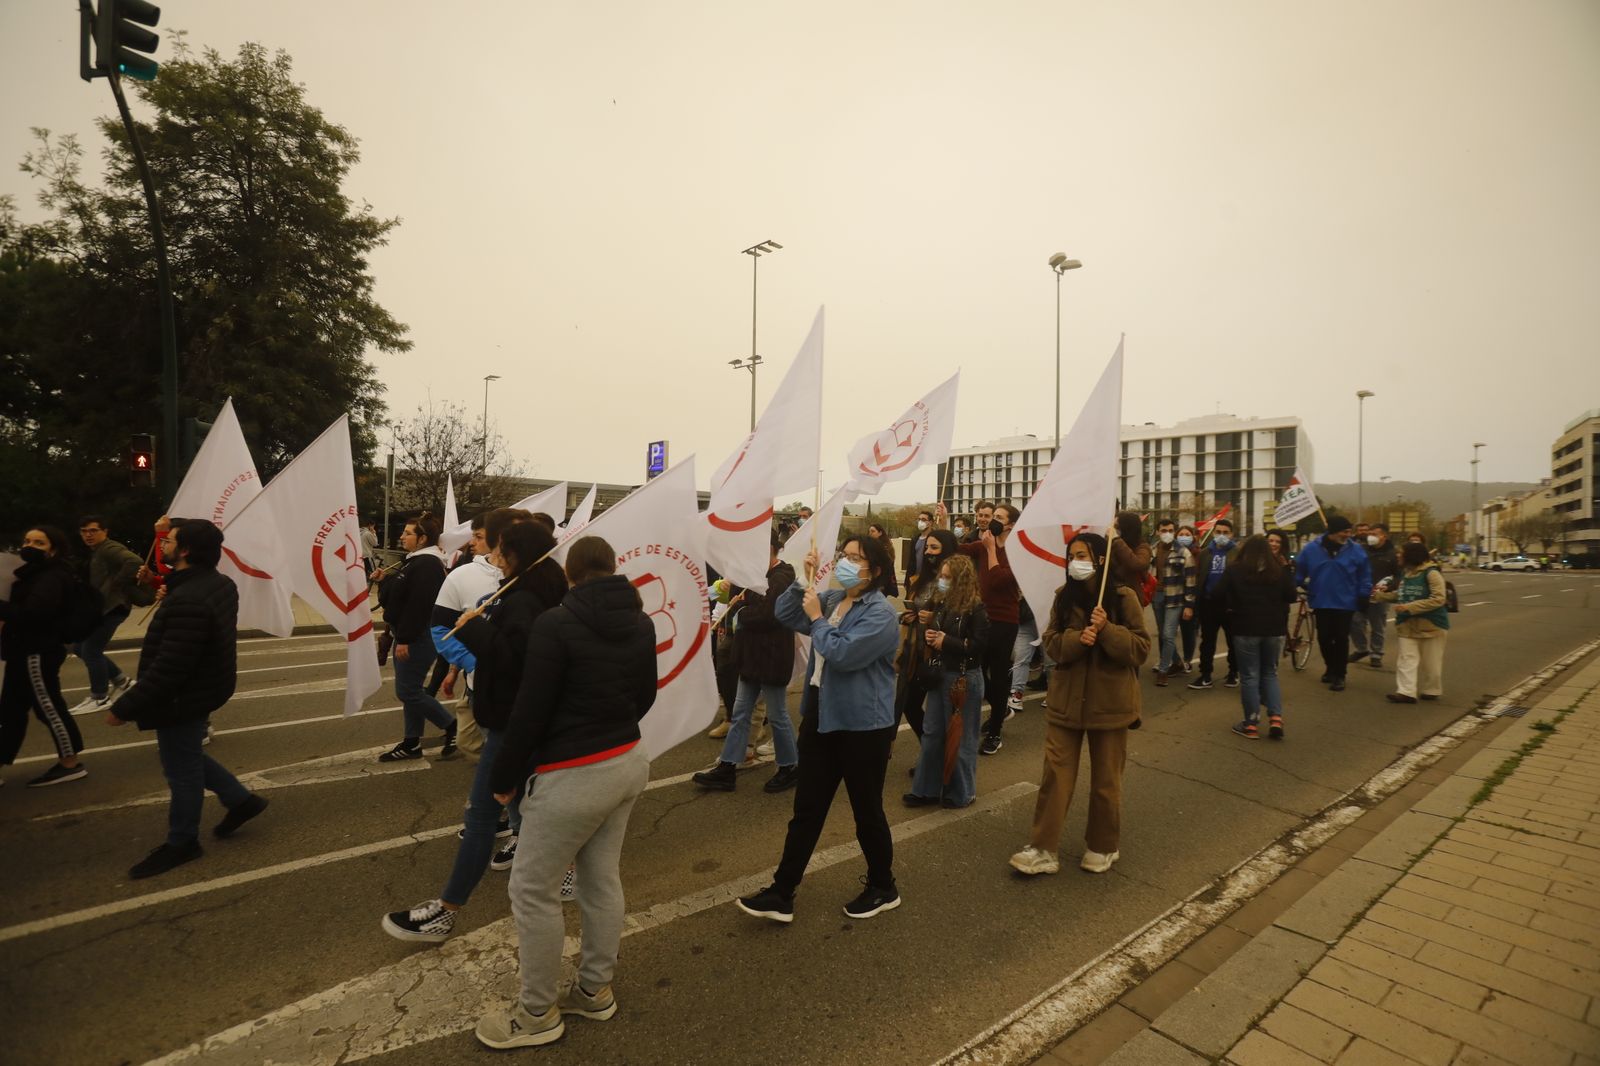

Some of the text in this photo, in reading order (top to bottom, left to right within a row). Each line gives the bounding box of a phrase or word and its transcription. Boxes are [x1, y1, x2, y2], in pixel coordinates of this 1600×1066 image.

[651, 443, 661, 466] P
[617, 544, 710, 622] NTE DE ESTUDIANTES
